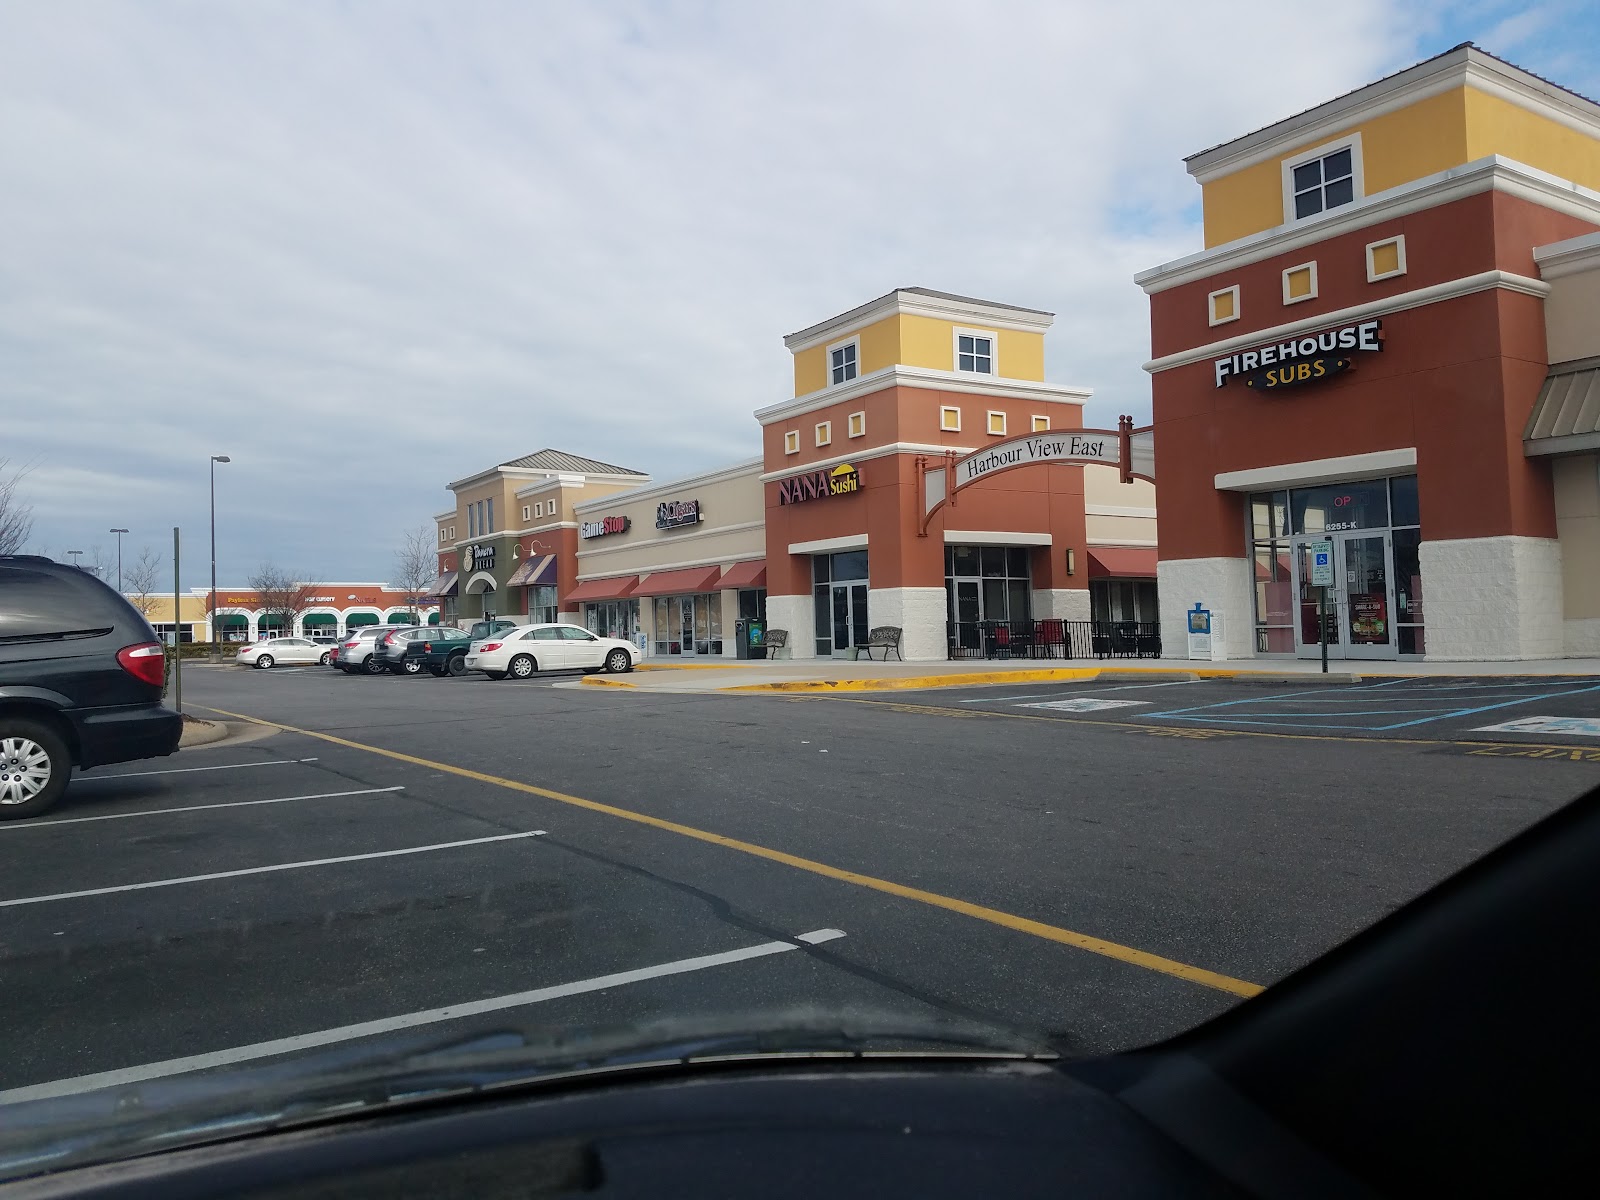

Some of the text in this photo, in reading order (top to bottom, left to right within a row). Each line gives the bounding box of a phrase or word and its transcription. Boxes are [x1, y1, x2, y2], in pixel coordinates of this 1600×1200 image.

[1214, 320, 1379, 388] FIREHOUSE
[1266, 359, 1326, 387] SUBS
[967, 436, 1105, 478] Harbour View East
[780, 471, 858, 505] NANA Sushi
[580, 515, 625, 539] GameStop
[1325, 521, 1357, 532] 6255-K
